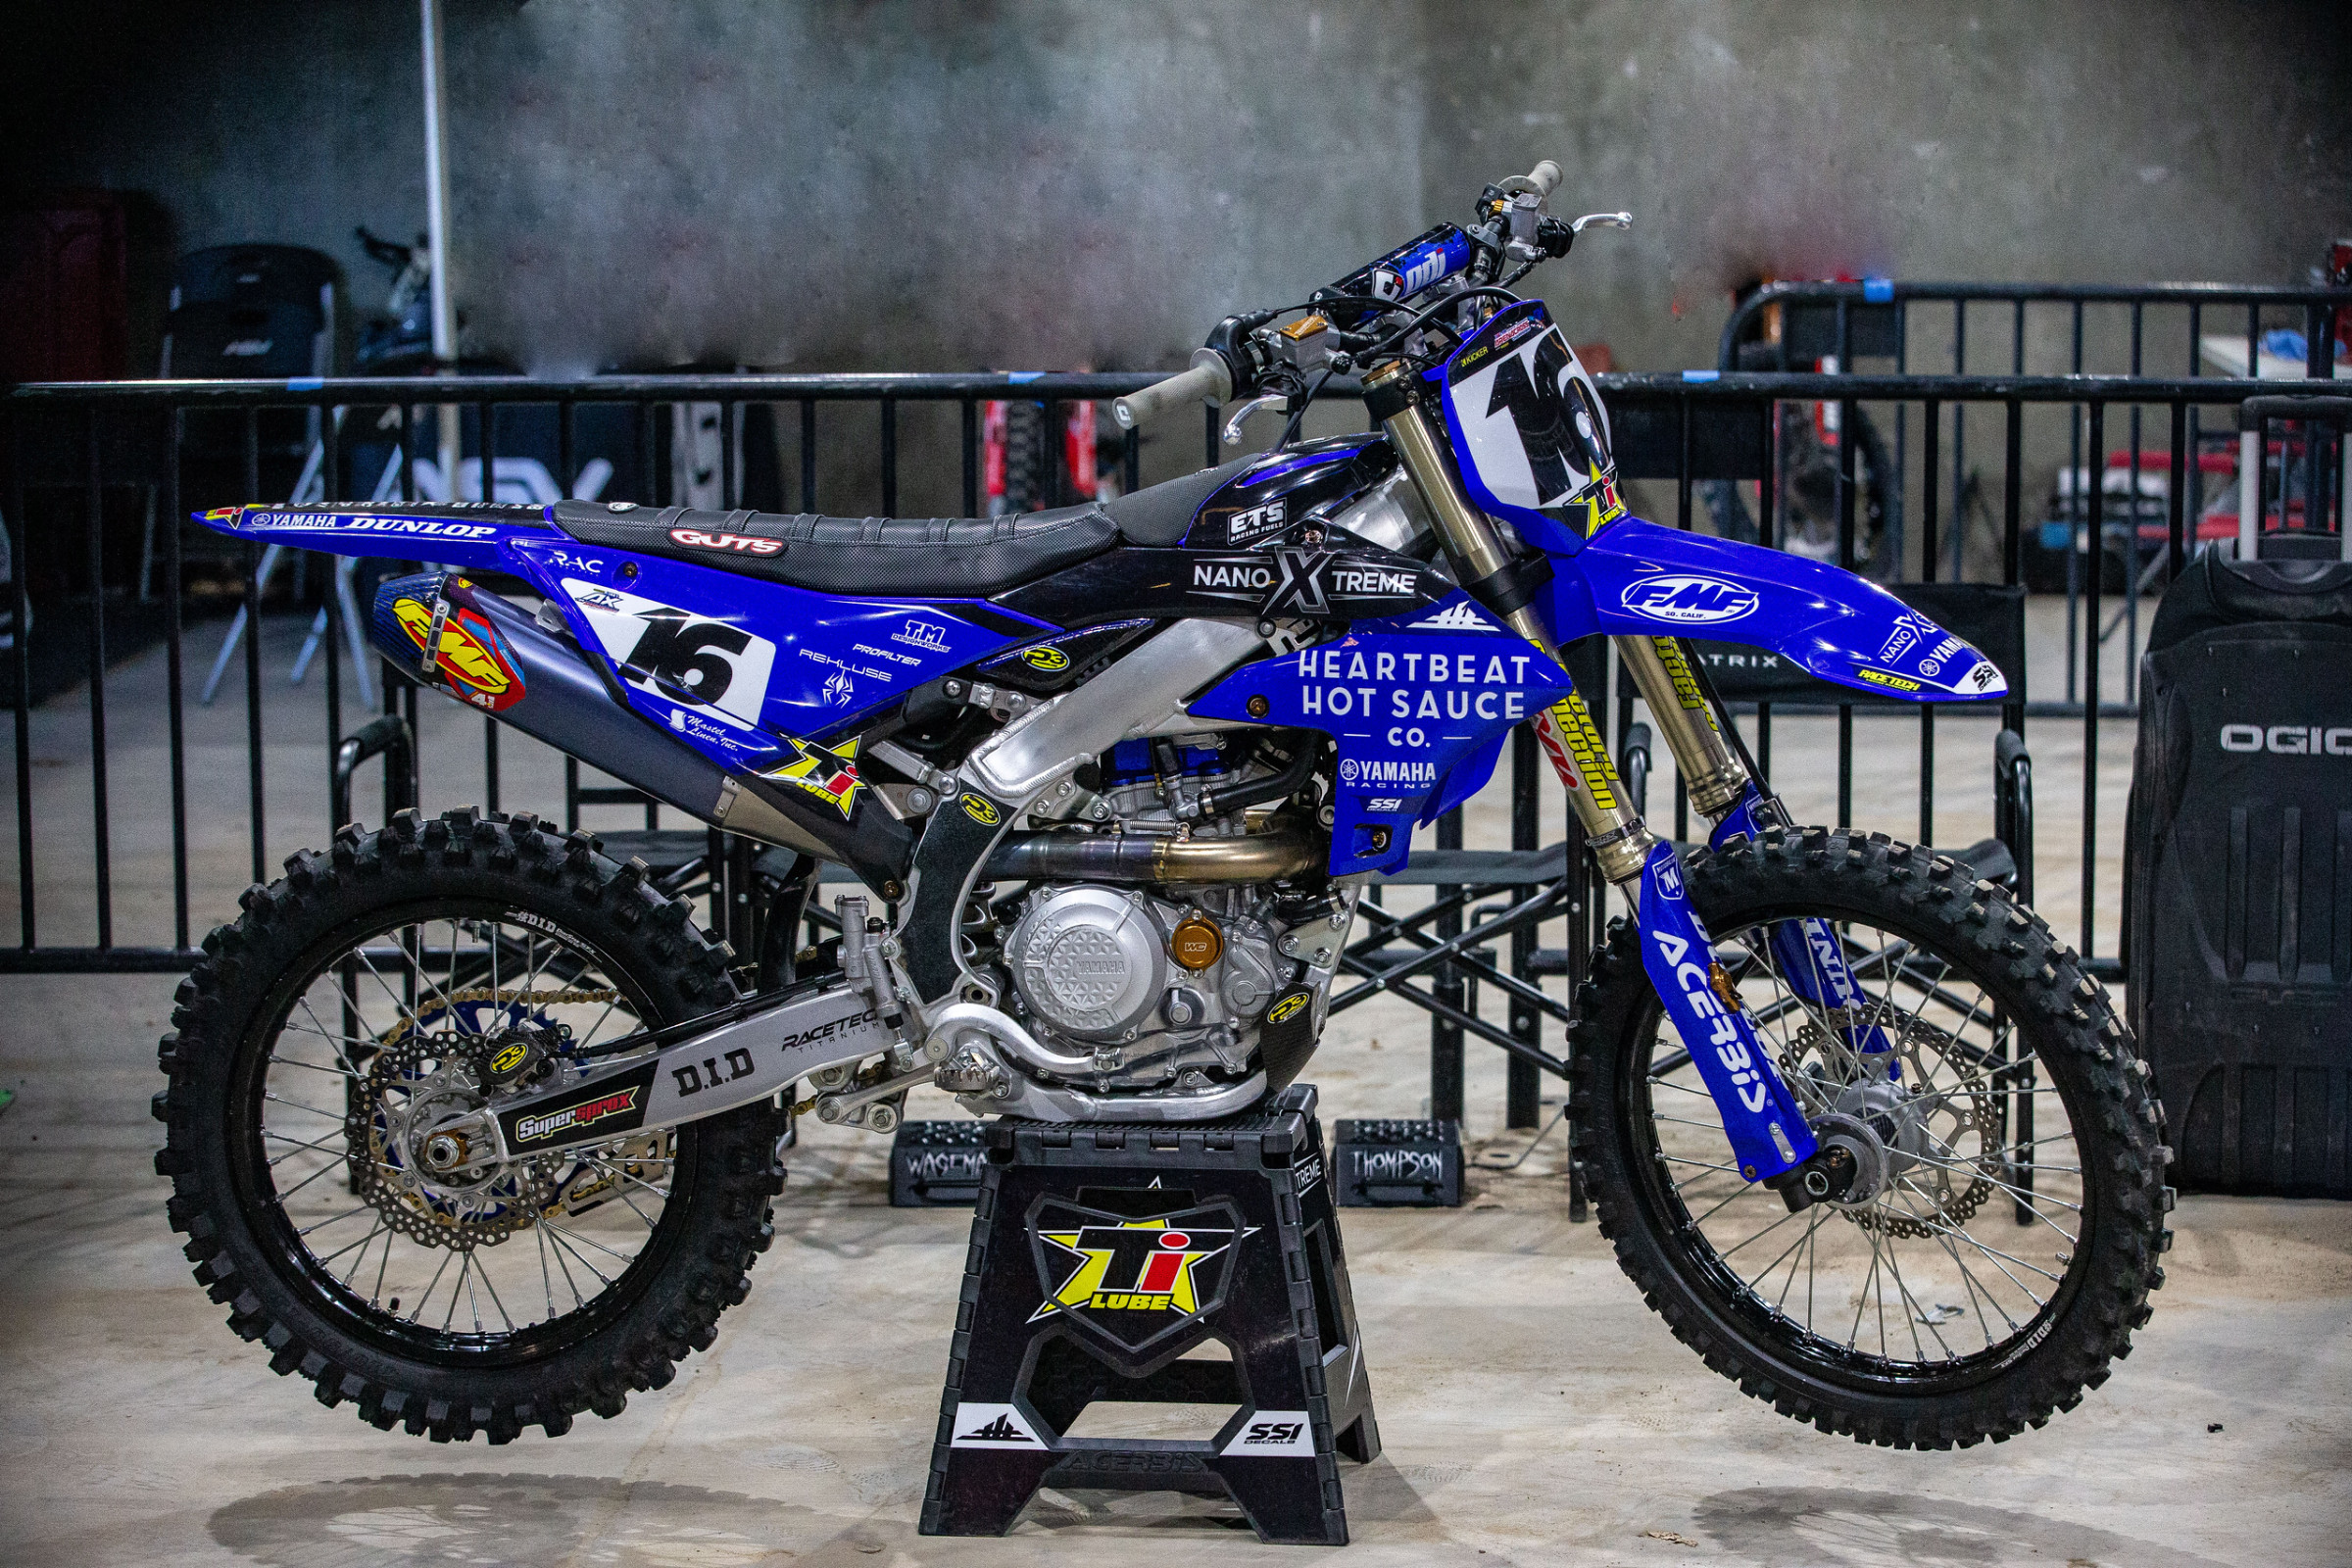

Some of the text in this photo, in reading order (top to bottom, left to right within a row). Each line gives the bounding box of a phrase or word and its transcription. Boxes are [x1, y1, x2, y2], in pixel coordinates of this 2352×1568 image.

[1465, 346, 1489, 365] KICKER
[271, 514, 497, 538] YAMAHA DUNLOP
[1230, 501, 1284, 534] ETS
[1598, 506, 1621, 525] LUBE
[670, 529, 784, 554] GUTS
[1230, 521, 1284, 542] RACING FUELS
[1193, 564, 1271, 588] NANO
[1623, 582, 1759, 612] FMF
[891, 632, 952, 654] DESIGNWORKS
[905, 619, 946, 645] TM
[616, 607, 754, 706] 16
[853, 643, 922, 666] PROFILTER
[1880, 630, 1911, 663] NANO
[799, 648, 893, 682] REKLUSE
[1298, 650, 1530, 684] HEARTBEAT
[1683, 654, 1778, 667] ATRIX
[1301, 685, 1525, 719] HOT SAUCE
[687, 714, 725, 737] Mastel
[1387, 726, 1431, 748] CO.
[685, 728, 738, 752] Linen, Inc.
[1359, 760, 1437, 781] YAMAHA
[795, 779, 842, 805] LUBE
[1368, 798, 1403, 809] SSI
[1077, 960, 1126, 975] YAMAHA
[781, 1007, 877, 1053] RACETEC
[1652, 929, 1767, 1113] ACERBIS
[798, 1022, 880, 1054] TITANIUM
[671, 1048, 755, 1098] D.I.D
[906, 1152, 988, 1177] WAGEMA
[1351, 1149, 1443, 1182] THOMPSON
[1088, 1293, 1173, 1310] LUBE
[1245, 1423, 1304, 1441] SSI
[1056, 1449, 1208, 1471] ACERBIS
